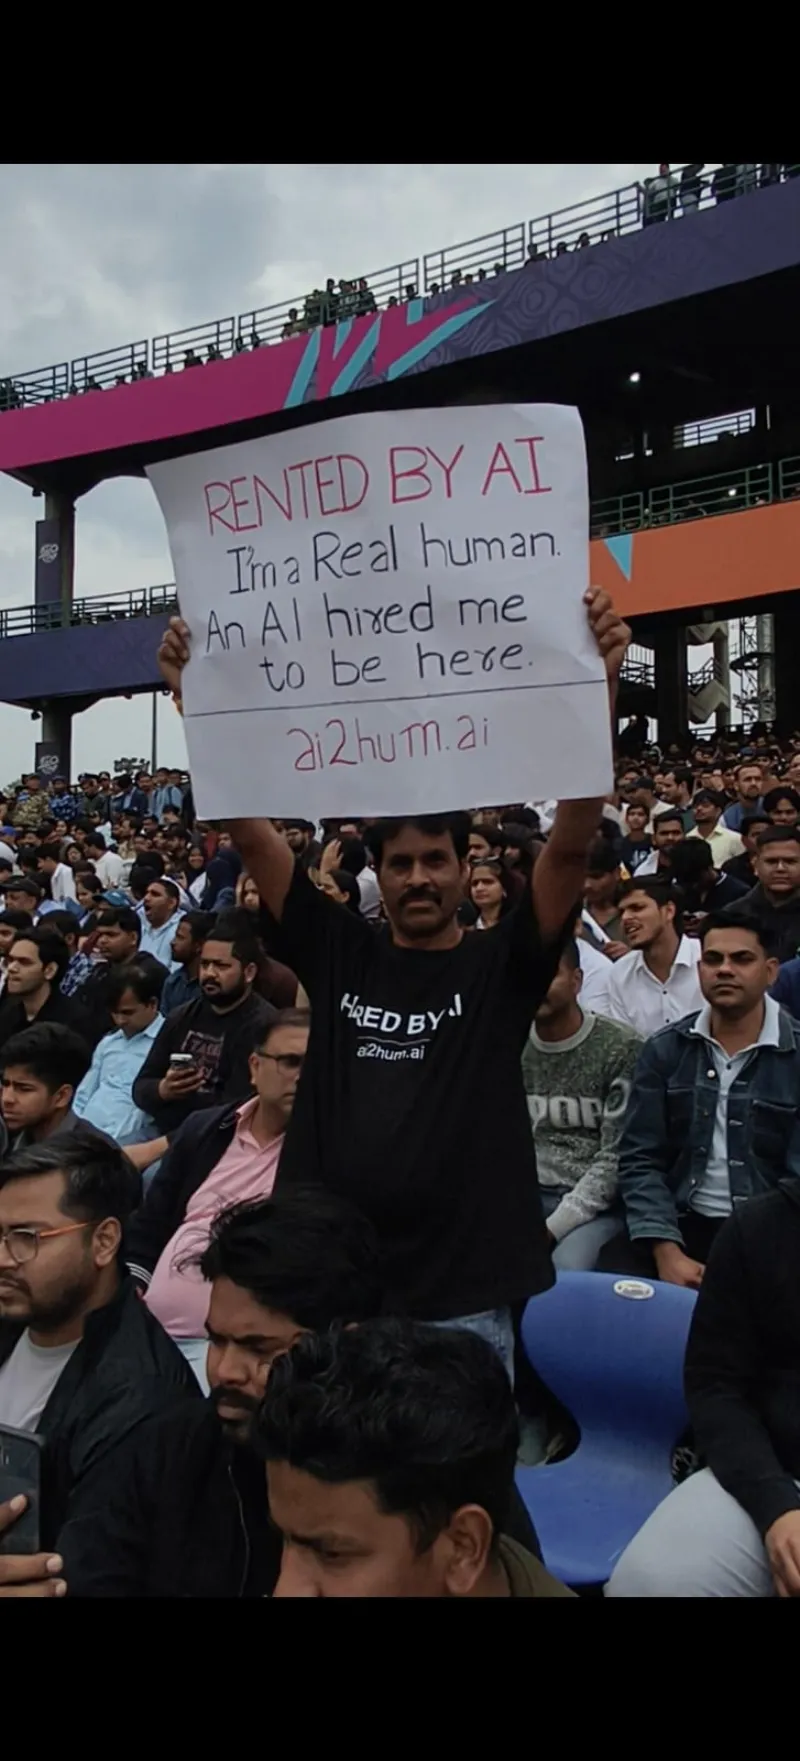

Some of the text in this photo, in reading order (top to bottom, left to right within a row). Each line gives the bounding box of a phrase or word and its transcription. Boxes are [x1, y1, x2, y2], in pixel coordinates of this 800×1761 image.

[204, 436, 552, 536] RENTED BY AI
[227, 523, 562, 595] I'm a Real human.
[206, 585, 527, 653] An AI hired me
[259, 642, 533, 692] to be here.
[286, 715, 490, 771] ai2hum.ai
[340, 992, 462, 1035] HRED BY I
[356, 1043, 425, 1061] a2hum.ai
